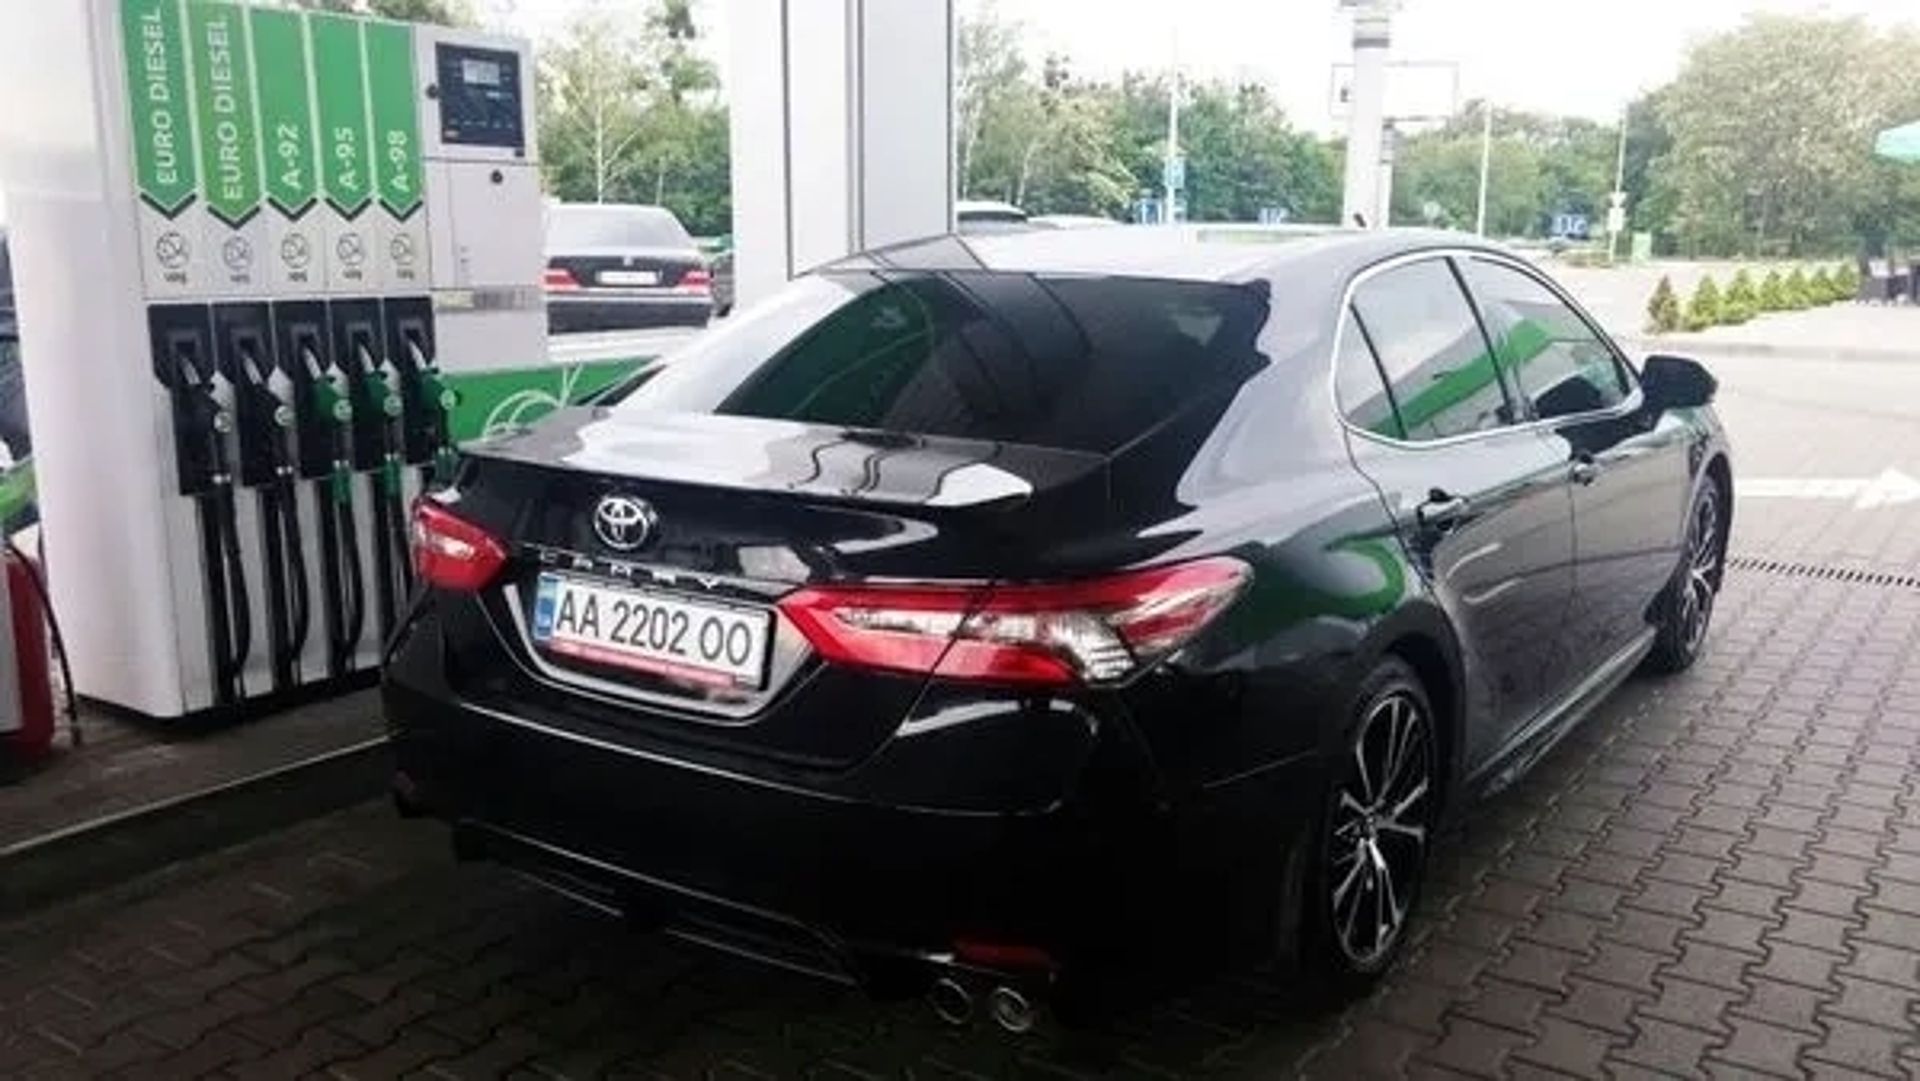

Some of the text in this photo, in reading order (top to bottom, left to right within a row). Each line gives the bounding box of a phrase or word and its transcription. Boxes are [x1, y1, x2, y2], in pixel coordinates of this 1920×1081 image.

[141, 7, 178, 185] EURO DIESEL
[206, 15, 244, 200] EURO DIESEL
[277, 123, 302, 190] A-92
[334, 126, 359, 192] A-95
[386, 130, 410, 193] A-98
[556, 589, 752, 667] AA 2202 OO
